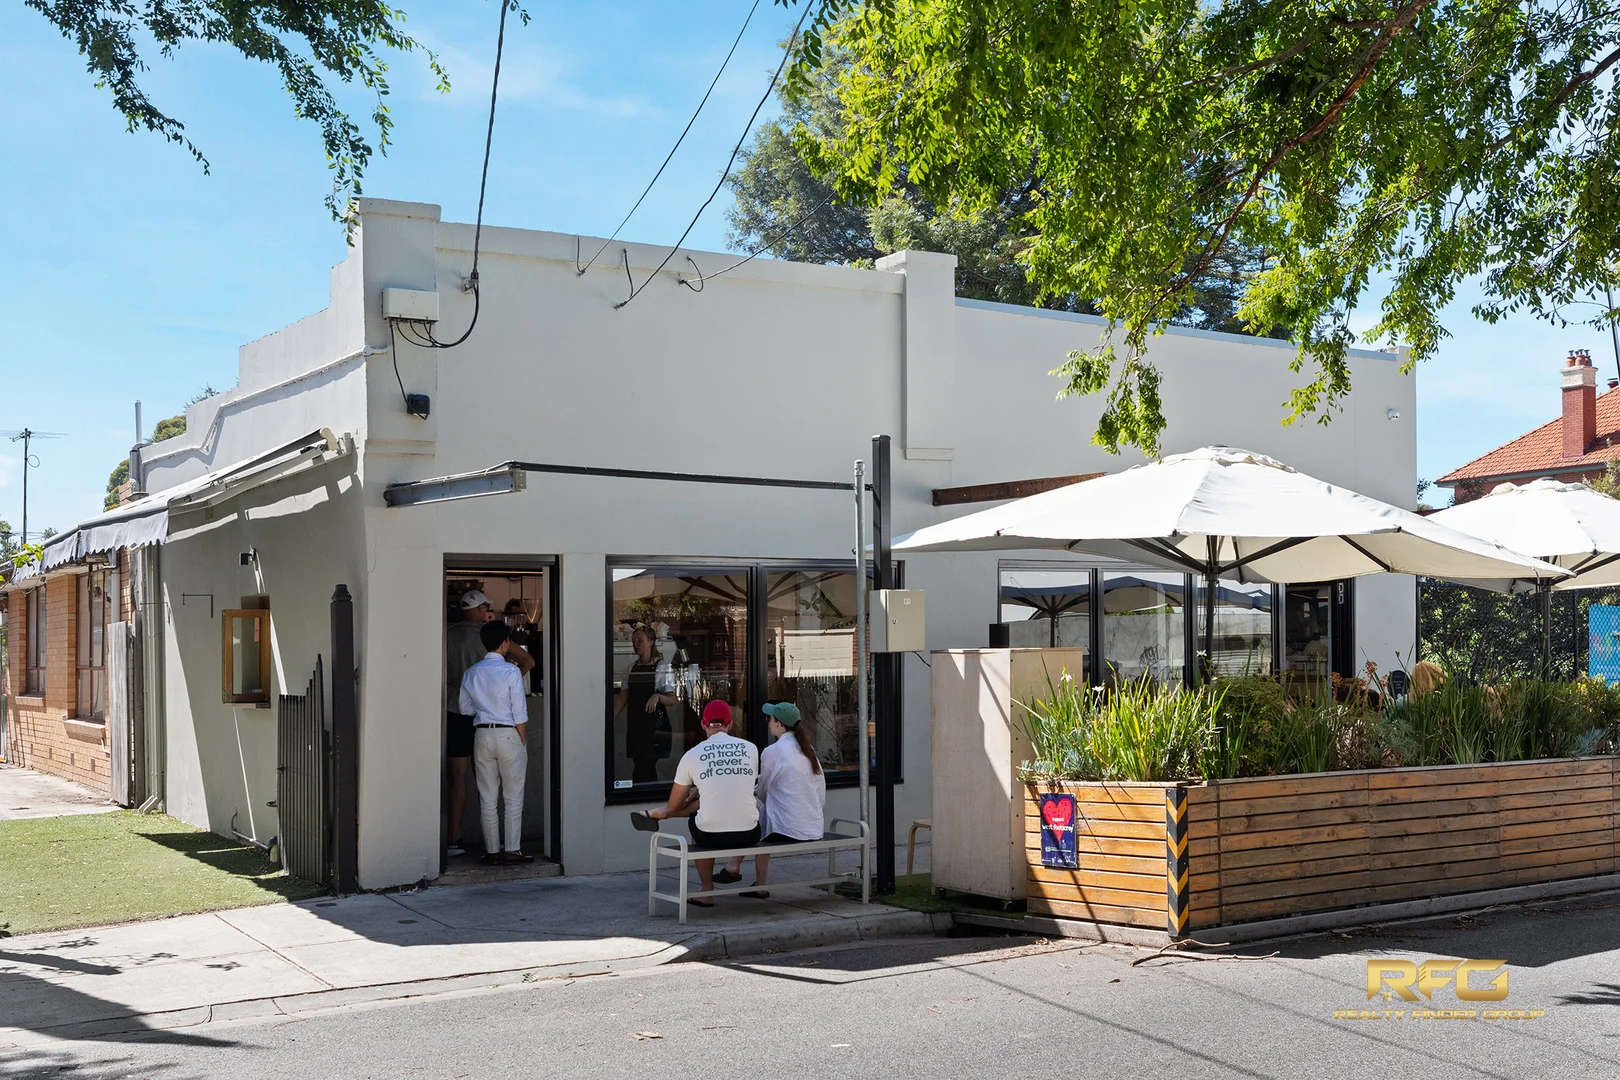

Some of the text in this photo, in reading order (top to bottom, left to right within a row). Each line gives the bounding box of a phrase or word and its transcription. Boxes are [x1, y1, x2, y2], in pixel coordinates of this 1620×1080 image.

[703, 743, 746, 751] always
[700, 750, 750, 761] on track,
[700, 767, 754, 780] off course
